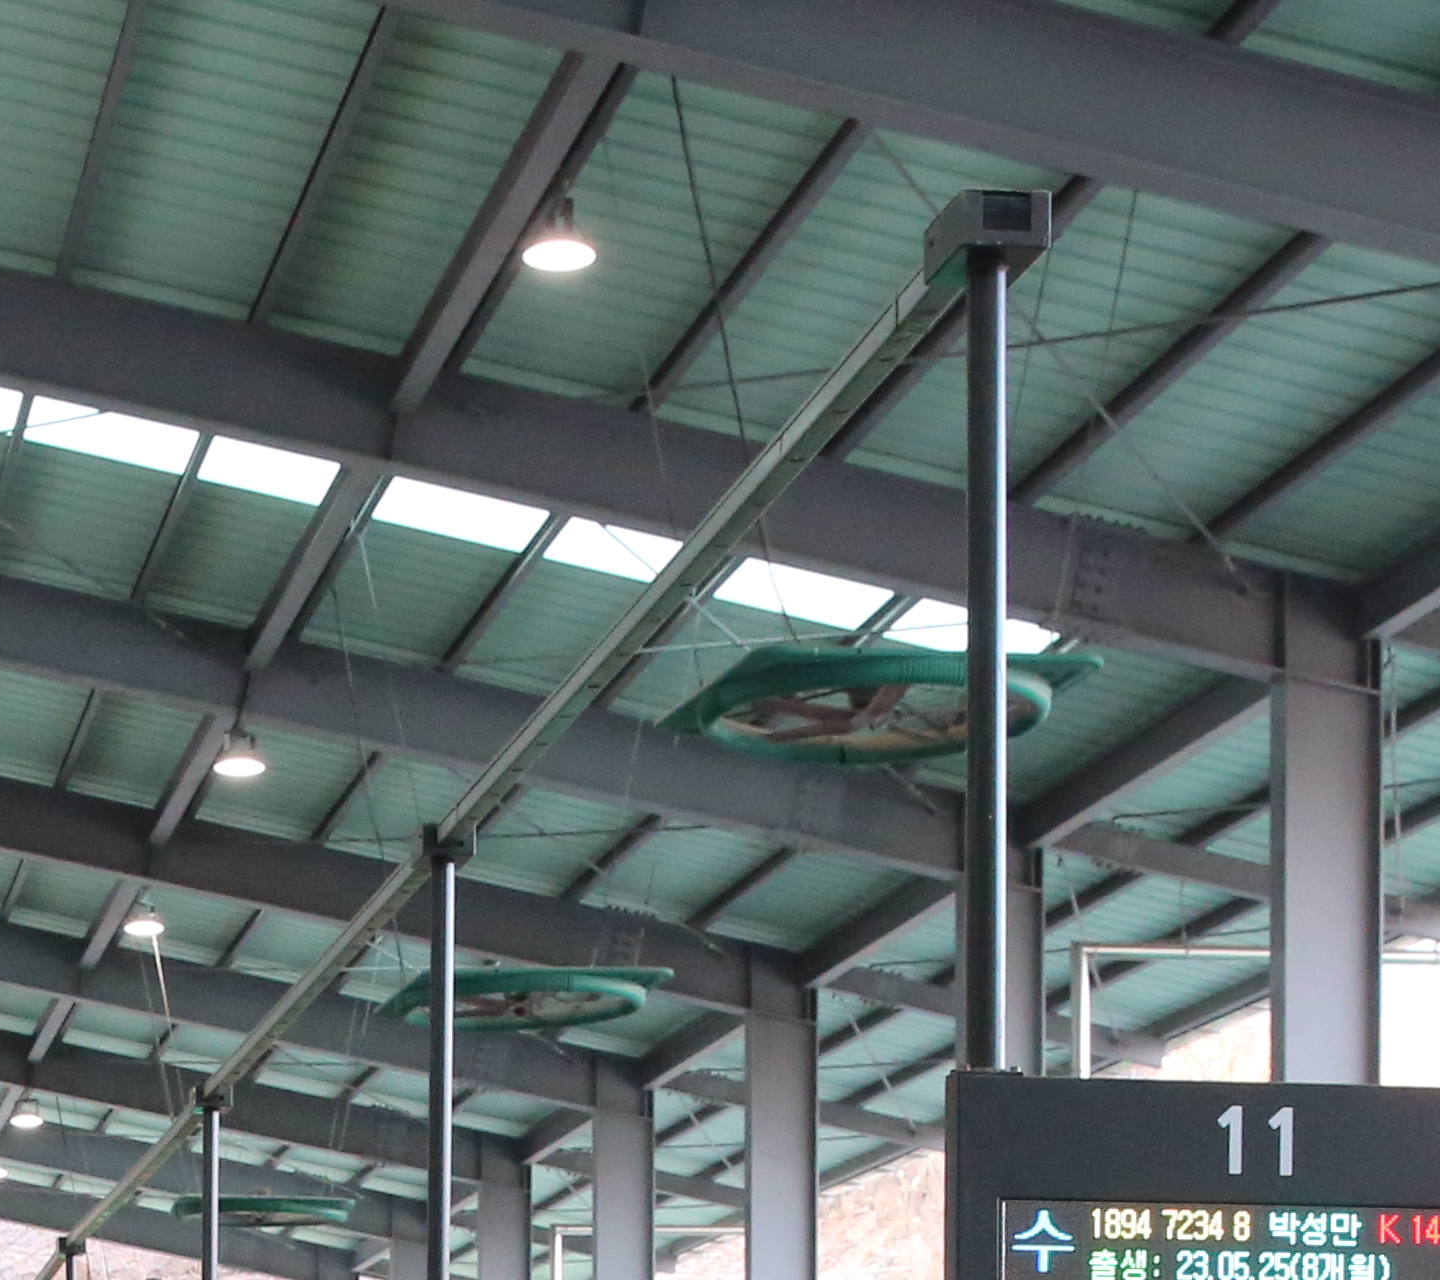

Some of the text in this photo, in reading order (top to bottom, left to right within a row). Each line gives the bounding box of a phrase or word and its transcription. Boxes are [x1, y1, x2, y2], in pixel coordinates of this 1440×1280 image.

[1217, 1105, 1294, 1176] 11
[1011, 1209, 1075, 1273] 수
[1091, 1207, 1153, 1240] 1894
[1161, 1208, 1225, 1241] 7234
[1233, 1210, 1251, 1242] 8
[1269, 1211, 1363, 1247] 박성만
[1377, 1213, 1403, 1245] K
